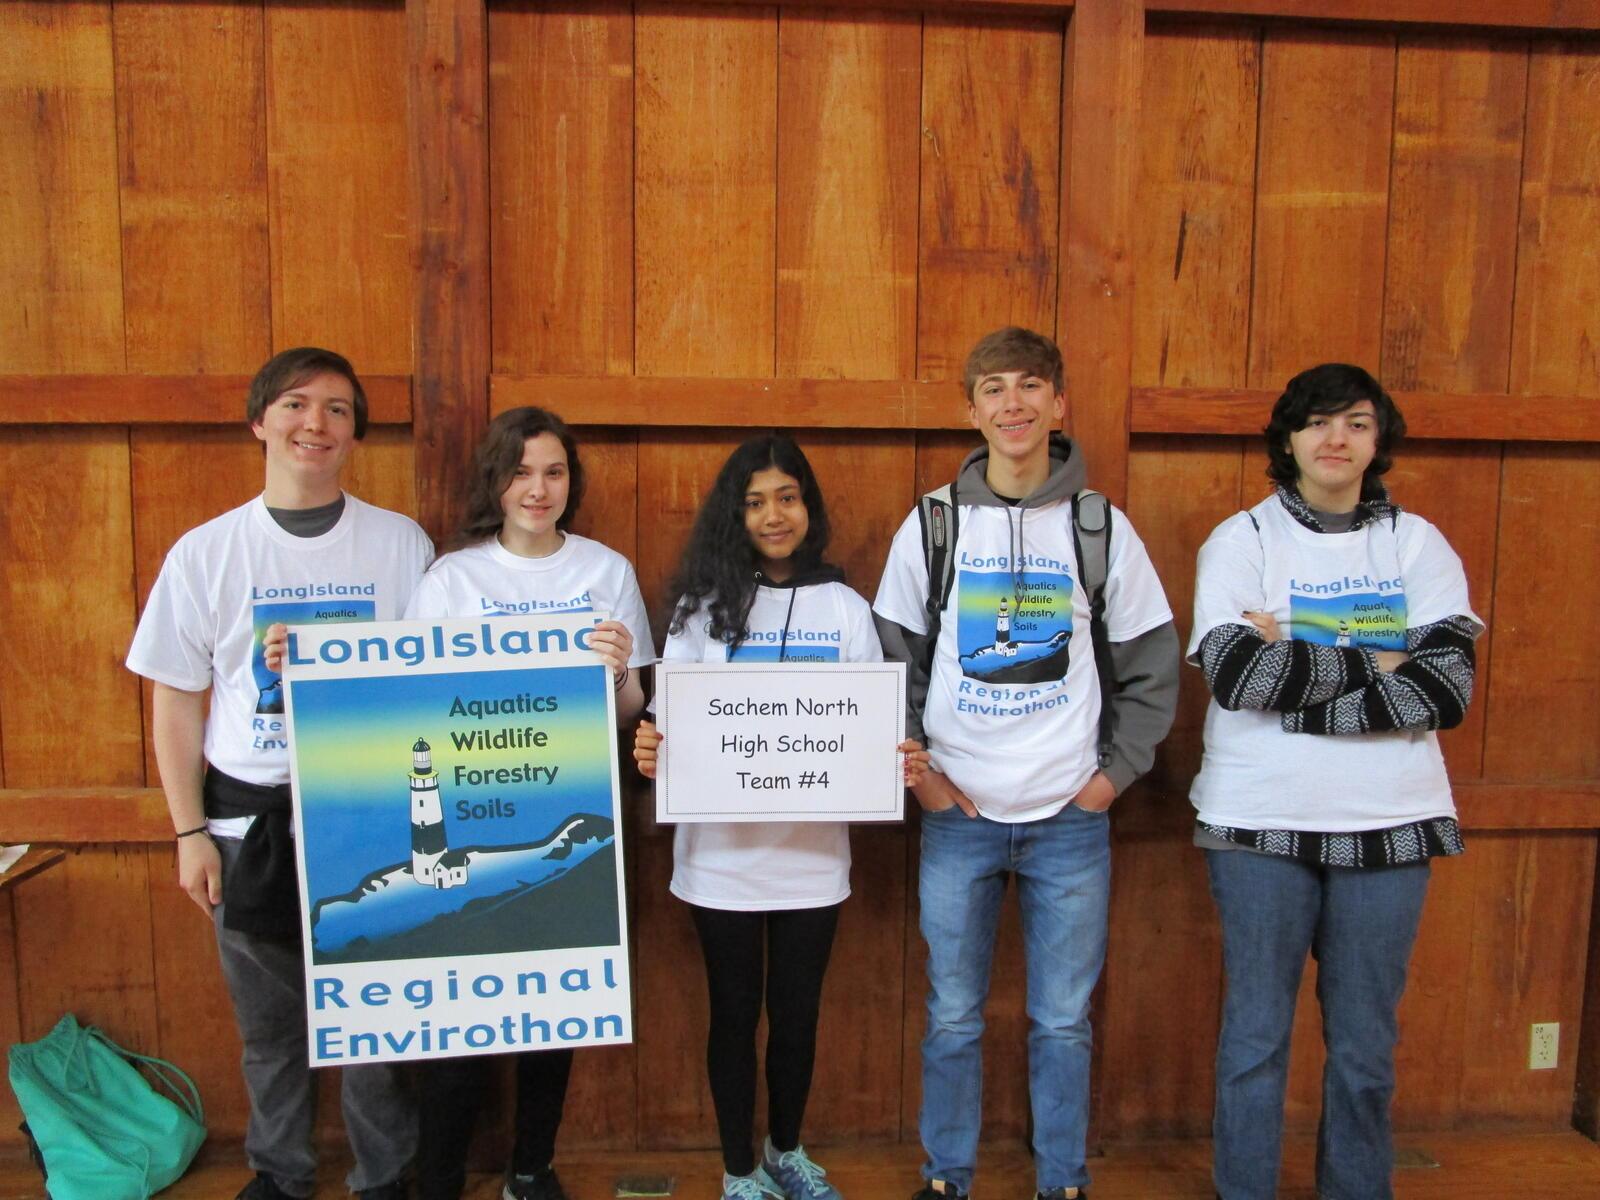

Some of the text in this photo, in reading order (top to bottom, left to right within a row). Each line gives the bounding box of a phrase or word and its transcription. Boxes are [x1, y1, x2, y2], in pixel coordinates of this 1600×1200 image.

[960, 551, 1070, 573] Longslan
[252, 583, 375, 600] LongIsland
[1290, 575, 1402, 594] LongIslnd
[481, 591, 592, 613] LongIsland
[1353, 602, 1392, 612] Aquat
[314, 609, 357, 620] Aquatics
[1354, 614, 1396, 625] Wildlife
[726, 628, 841, 643] ngIsland
[1013, 622, 1038, 631] Soils
[1357, 628, 1401, 638] Forestry
[784, 653, 825, 663] Aquatics
[449, 692, 559, 720] Aquatics
[708, 697, 859, 717] Sachem North
[957, 693, 1070, 717] Envirothon
[450, 727, 549, 752] Wildlife
[721, 734, 844, 758] High School
[454, 762, 560, 787] Forestry
[736, 771, 830, 790] Team #4
[455, 798, 517, 822] Soils
[313, 958, 619, 1011] Regional
[315, 1012, 624, 1060] Envirothon
